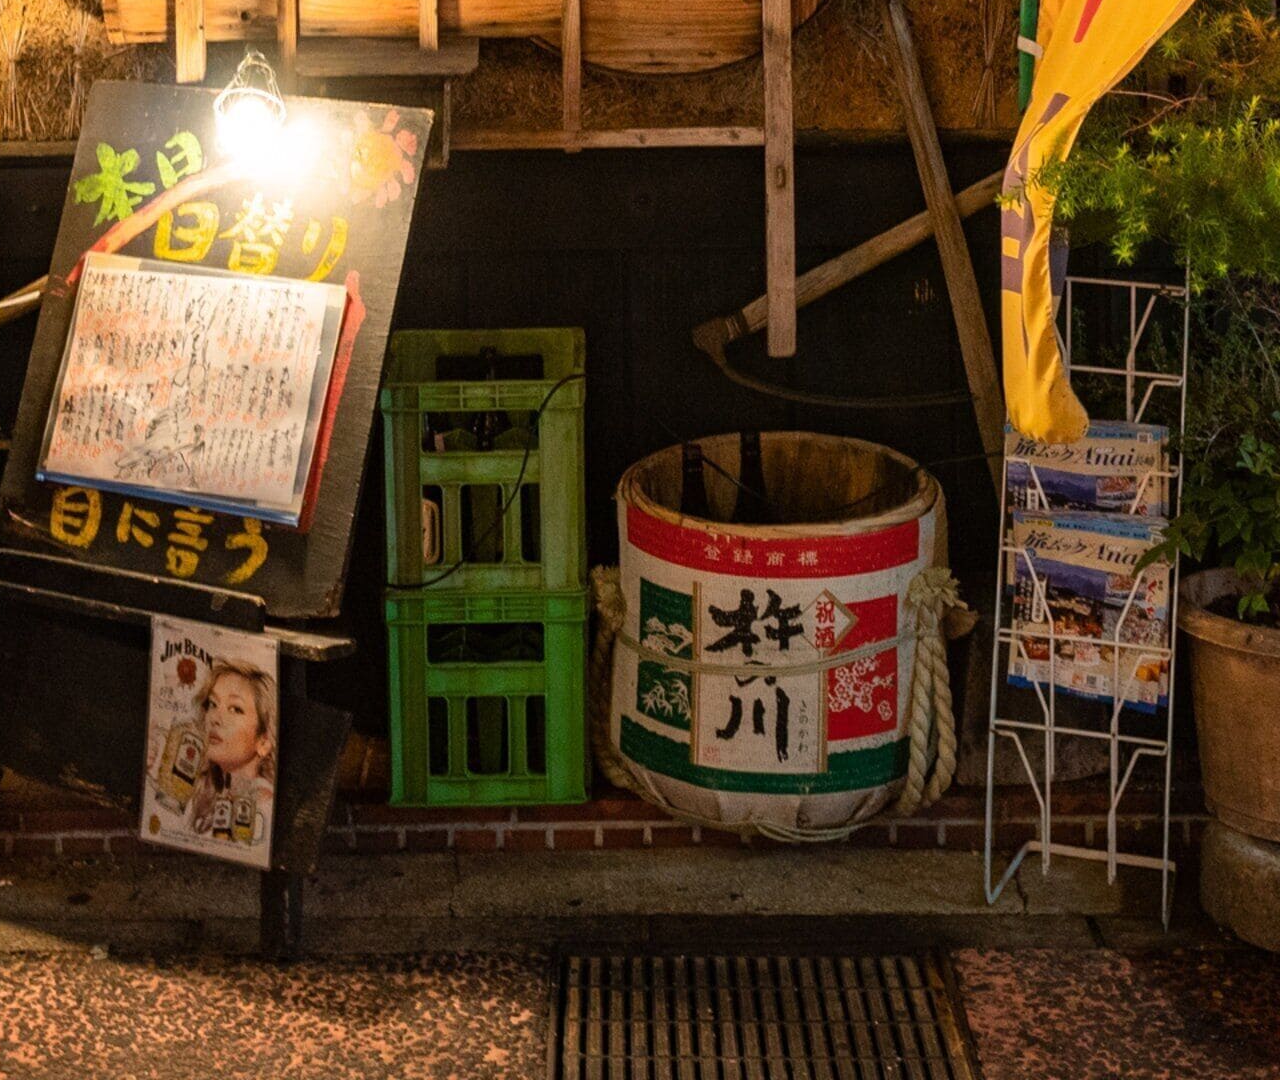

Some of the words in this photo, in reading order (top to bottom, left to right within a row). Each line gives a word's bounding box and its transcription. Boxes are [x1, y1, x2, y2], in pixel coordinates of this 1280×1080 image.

[153, 192, 350, 282] 日替り
[814, 600, 836, 648] 祝酒
[160, 639, 183, 663] JIM
